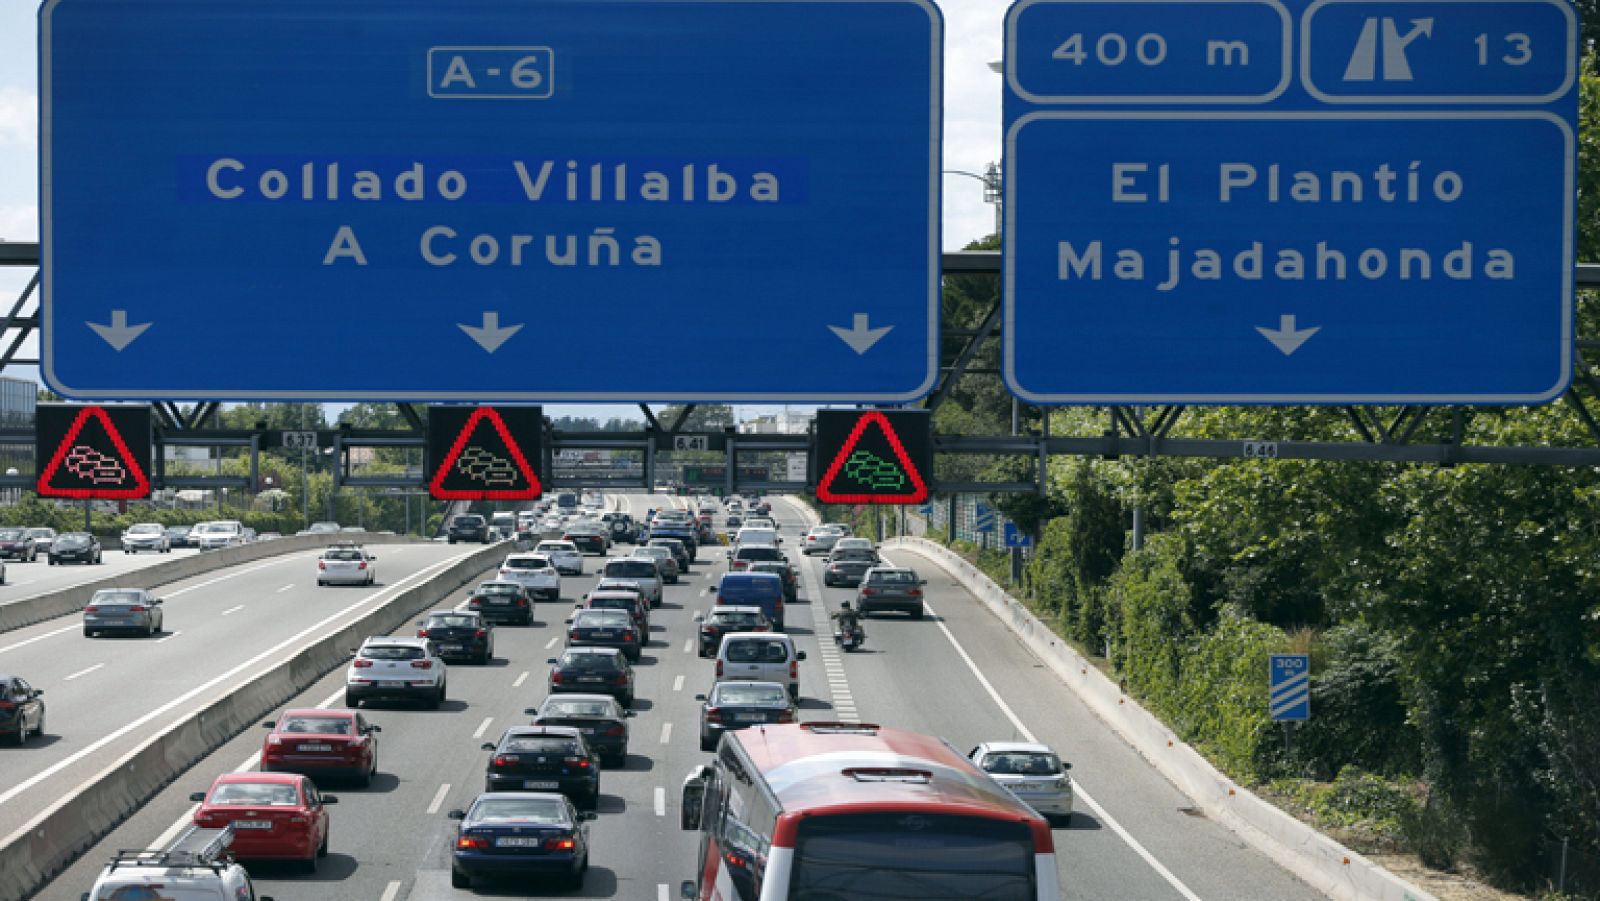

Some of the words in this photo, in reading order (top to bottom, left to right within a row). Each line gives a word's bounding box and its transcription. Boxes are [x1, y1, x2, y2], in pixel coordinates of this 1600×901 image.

[1052, 33, 1167, 66] 400
[1207, 40, 1249, 66] m
[1475, 33, 1533, 66] 13
[206, 158, 467, 200] Collado
[513, 160, 780, 202] Villalba
[1112, 163, 1169, 202] El
[1220, 160, 1464, 203] Plantío
[323, 225, 367, 266] A
[420, 225, 663, 267] Coruña
[1058, 237, 1516, 291] Majadahonda
[1277, 658, 1303, 668] 300
